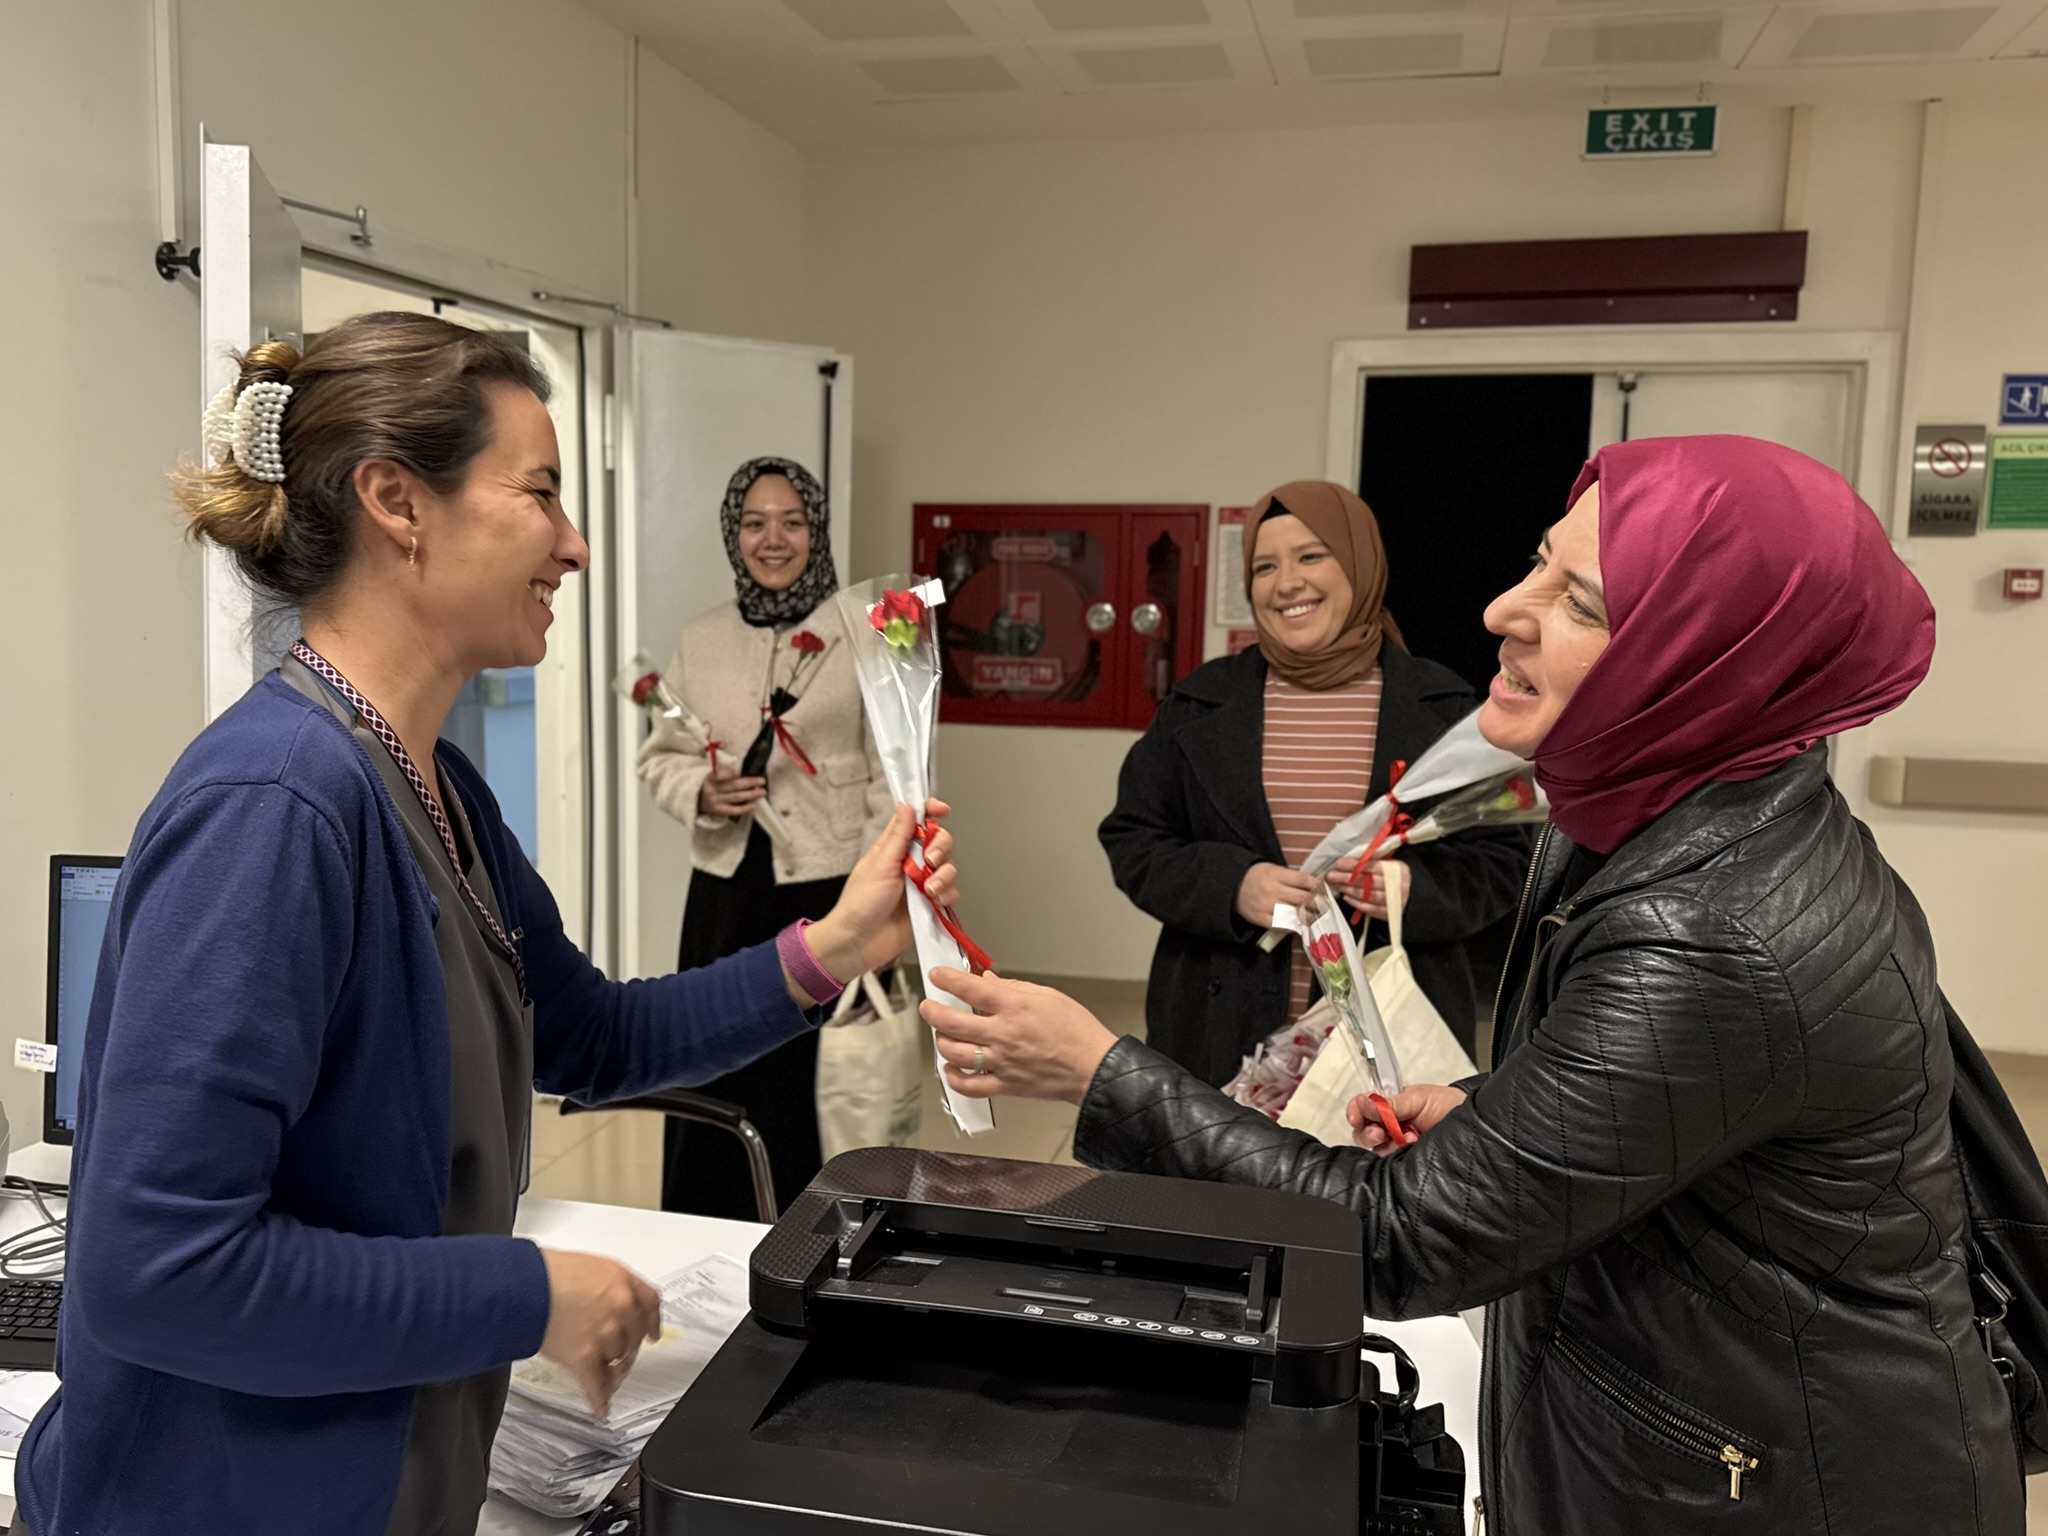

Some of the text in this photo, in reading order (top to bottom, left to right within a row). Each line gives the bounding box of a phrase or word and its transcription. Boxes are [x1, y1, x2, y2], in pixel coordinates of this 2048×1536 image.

[1605, 111, 1697, 132] EXIT
[1604, 131, 1695, 152] ÇIKIŞ
[1919, 491, 1972, 505] SİGARA
[981, 665, 1053, 681] YANGIN
